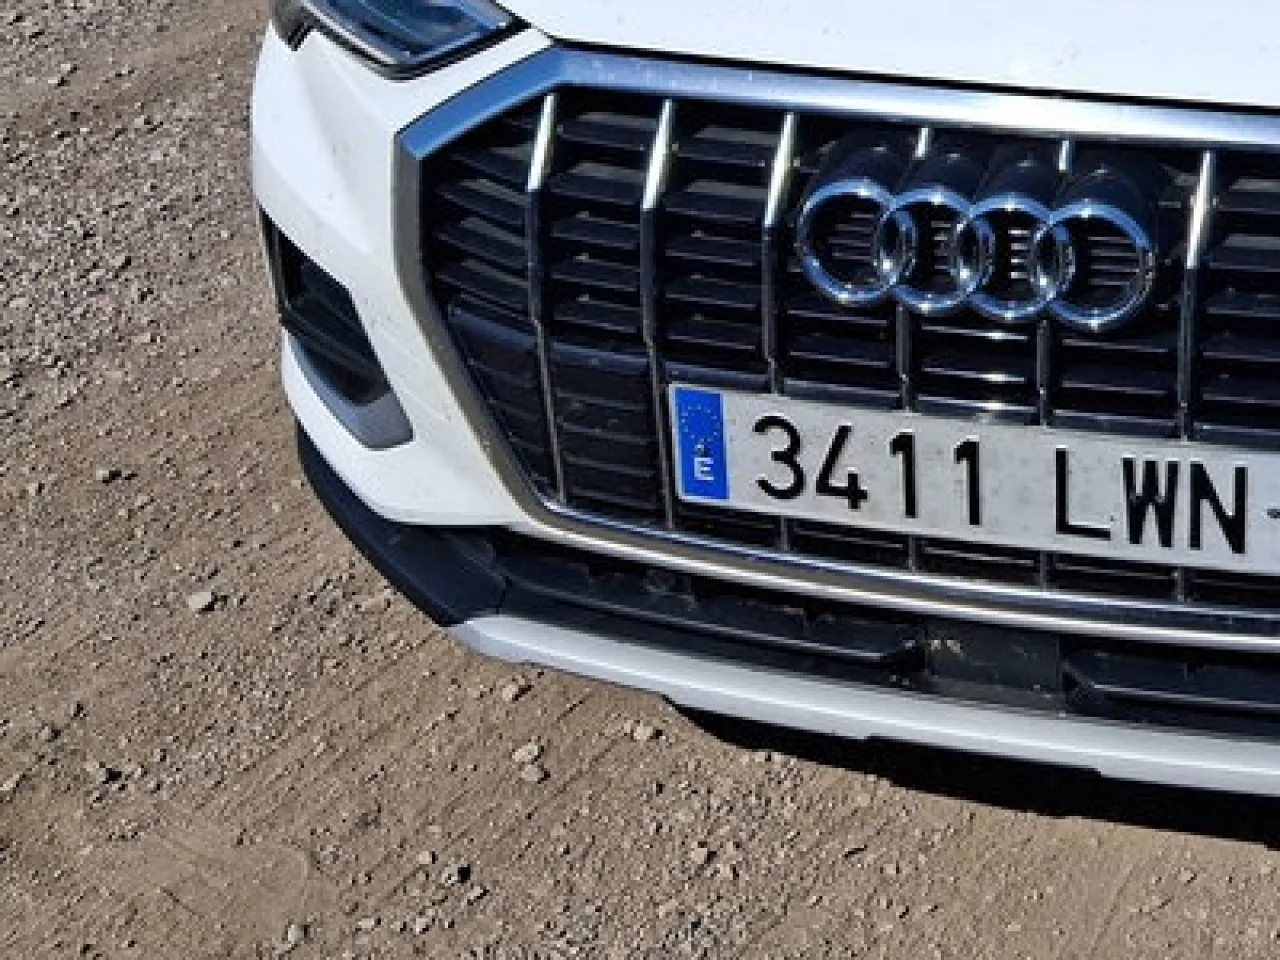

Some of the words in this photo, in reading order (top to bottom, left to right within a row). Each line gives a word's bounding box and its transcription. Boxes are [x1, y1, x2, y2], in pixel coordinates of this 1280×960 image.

[693, 457, 715, 481] E
[752, 415, 980, 525] 3411
[1055, 447, 1248, 554] LWN
